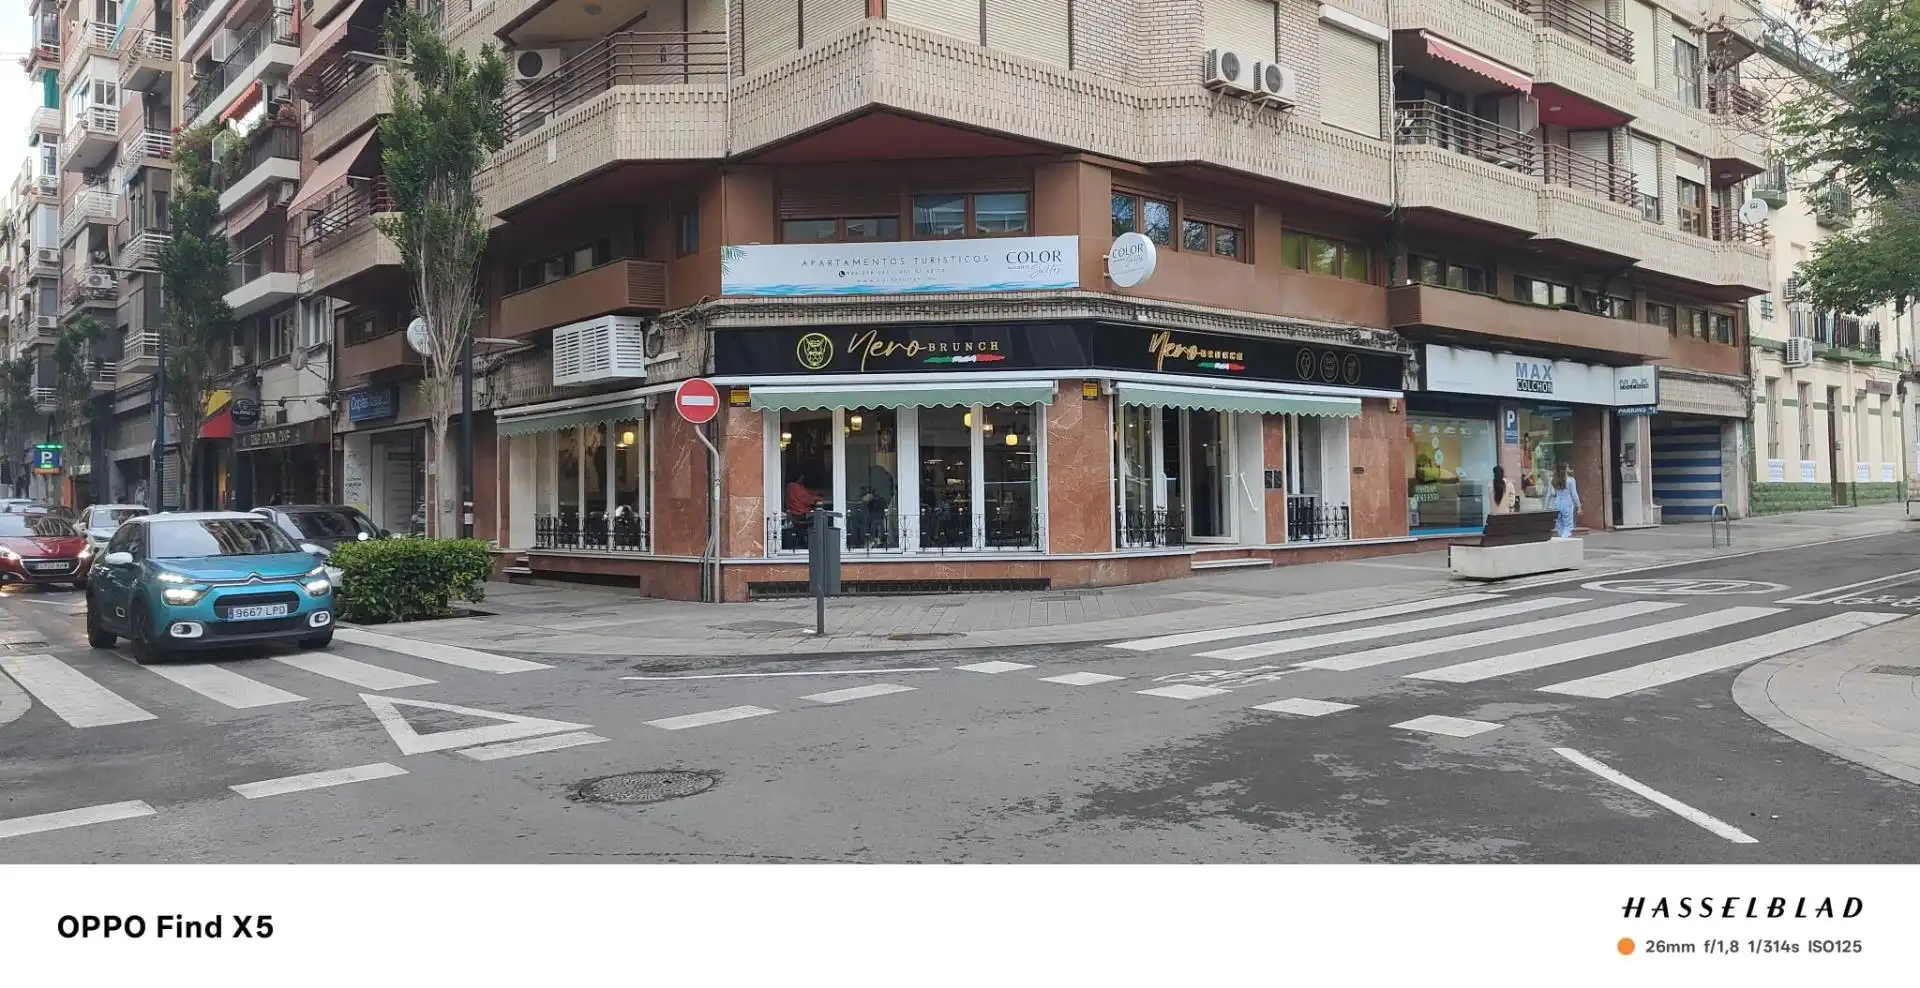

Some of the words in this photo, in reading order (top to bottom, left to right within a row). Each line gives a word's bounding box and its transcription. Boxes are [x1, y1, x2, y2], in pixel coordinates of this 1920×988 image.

[1006, 250, 1062, 264] COLOR
[1112, 243, 1144, 259] COLOR
[801, 257, 906, 267] APARTAMENTOS
[847, 329, 926, 372] Nero
[928, 341, 999, 352] BRUNCH
[1515, 361, 1553, 380] MAX
[1506, 410, 1515, 428] P
[41, 451, 53, 464] P
[235, 607, 263, 618] 9667
